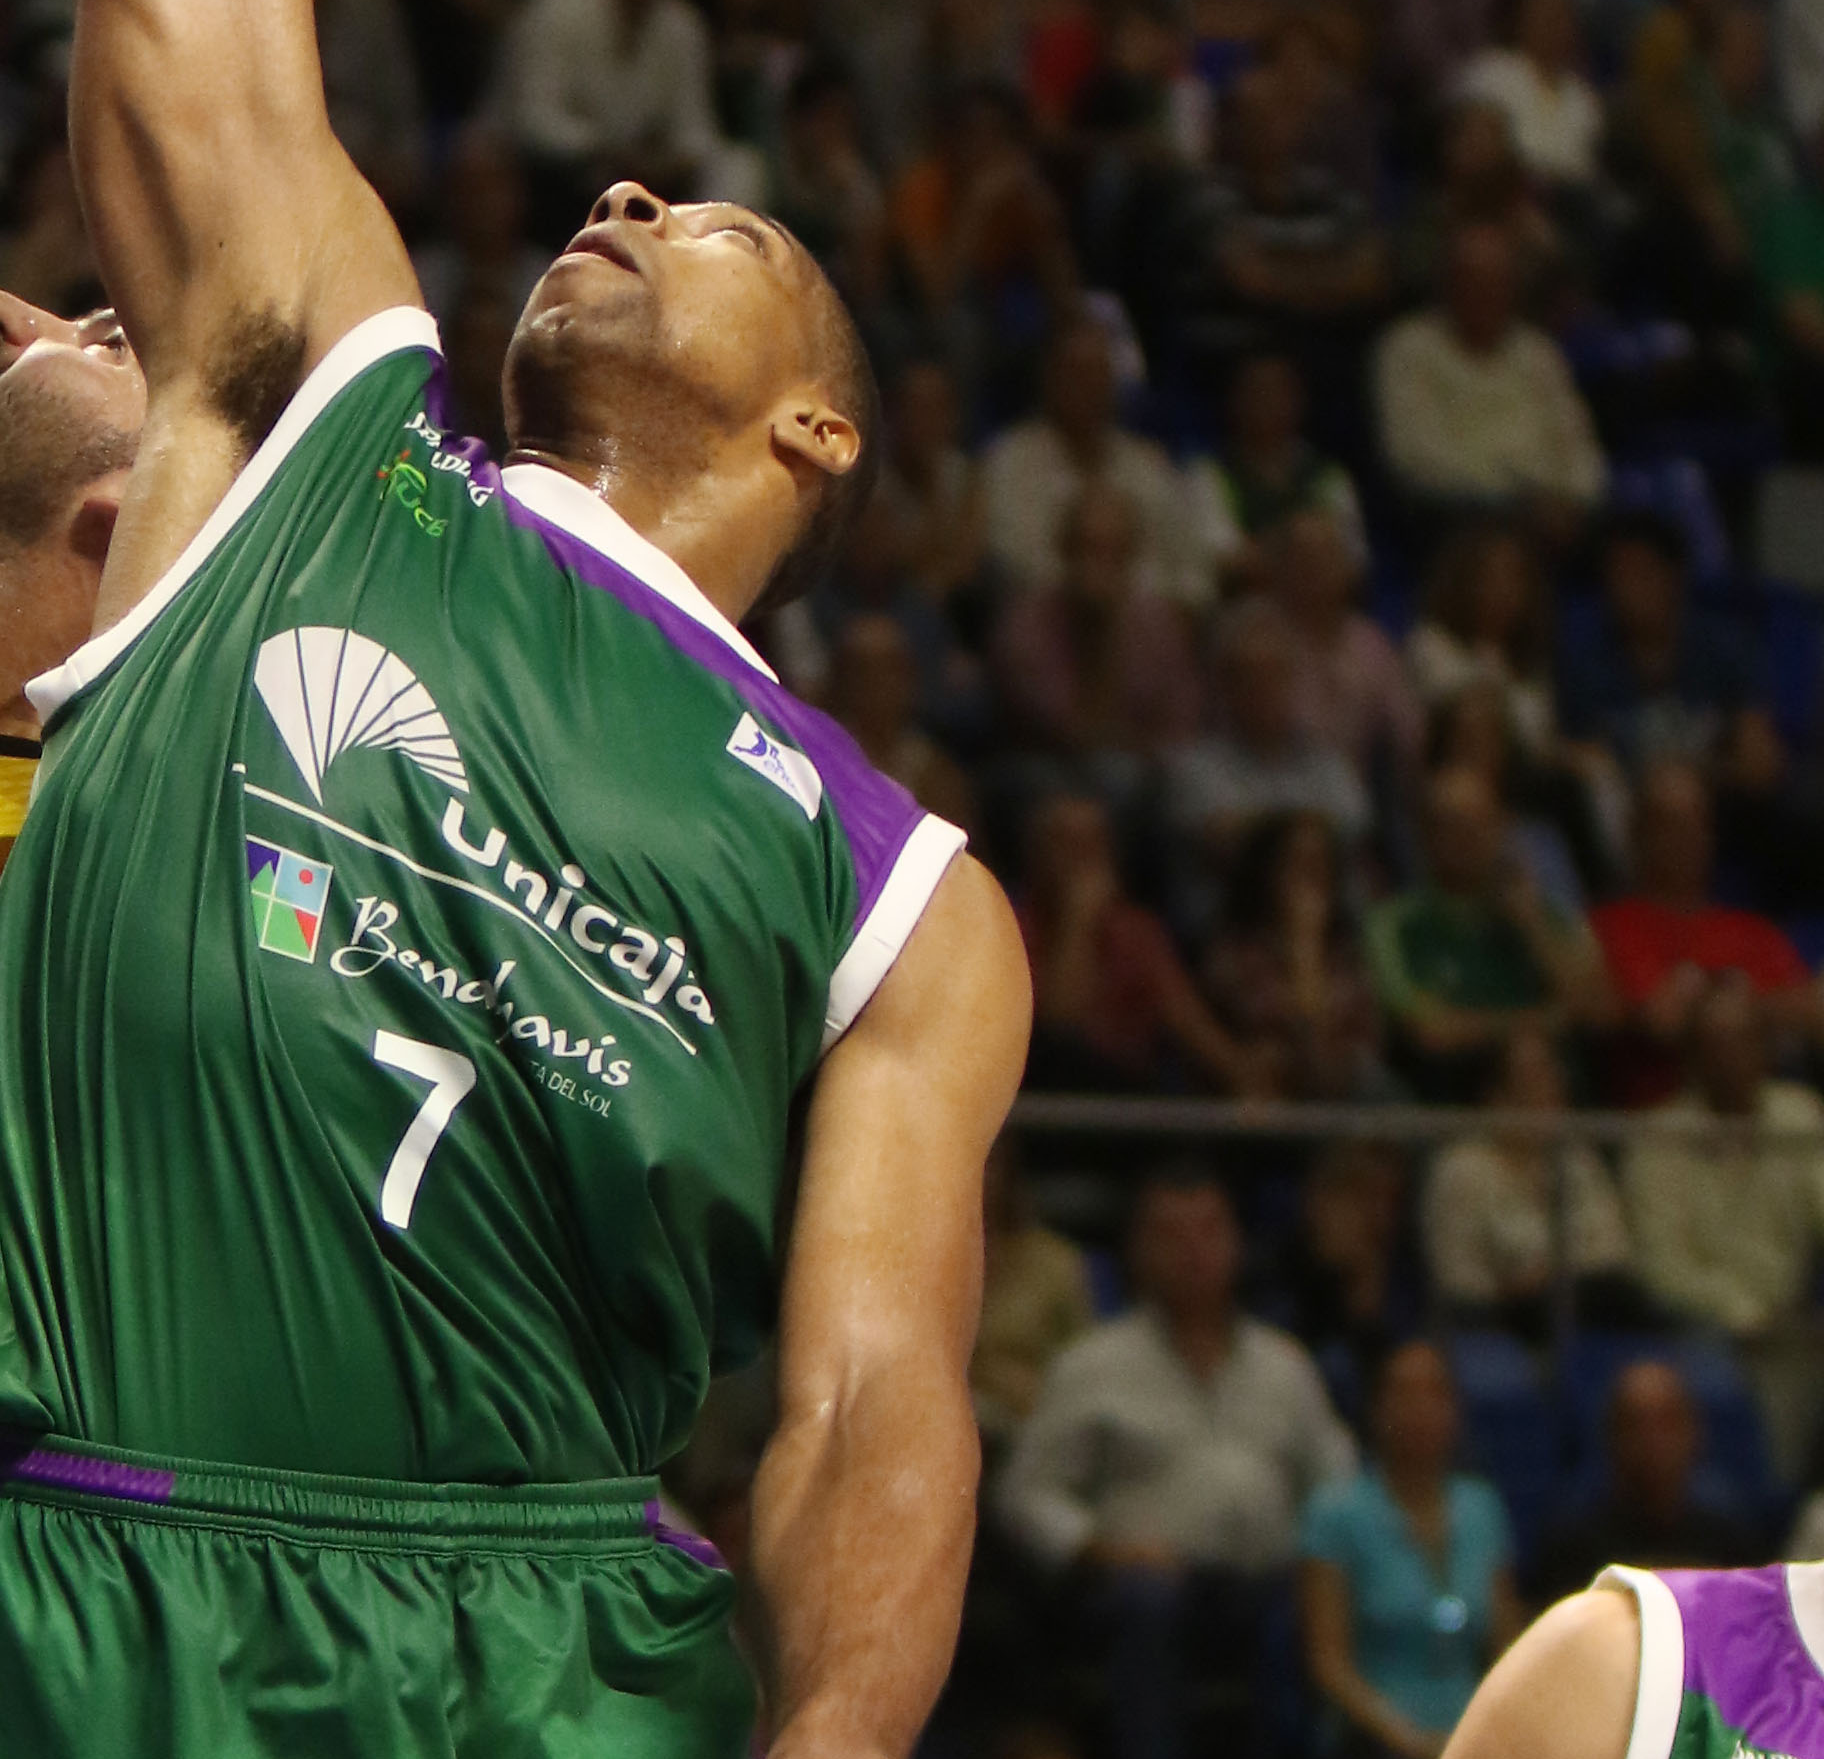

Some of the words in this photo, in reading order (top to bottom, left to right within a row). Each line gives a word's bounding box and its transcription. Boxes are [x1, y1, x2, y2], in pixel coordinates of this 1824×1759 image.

[441, 796, 715, 1026] Unicaja
[373, 1028, 477, 1230] 7
[546, 1070, 577, 1102] DEL
[578, 1088, 612, 1119] SOL
